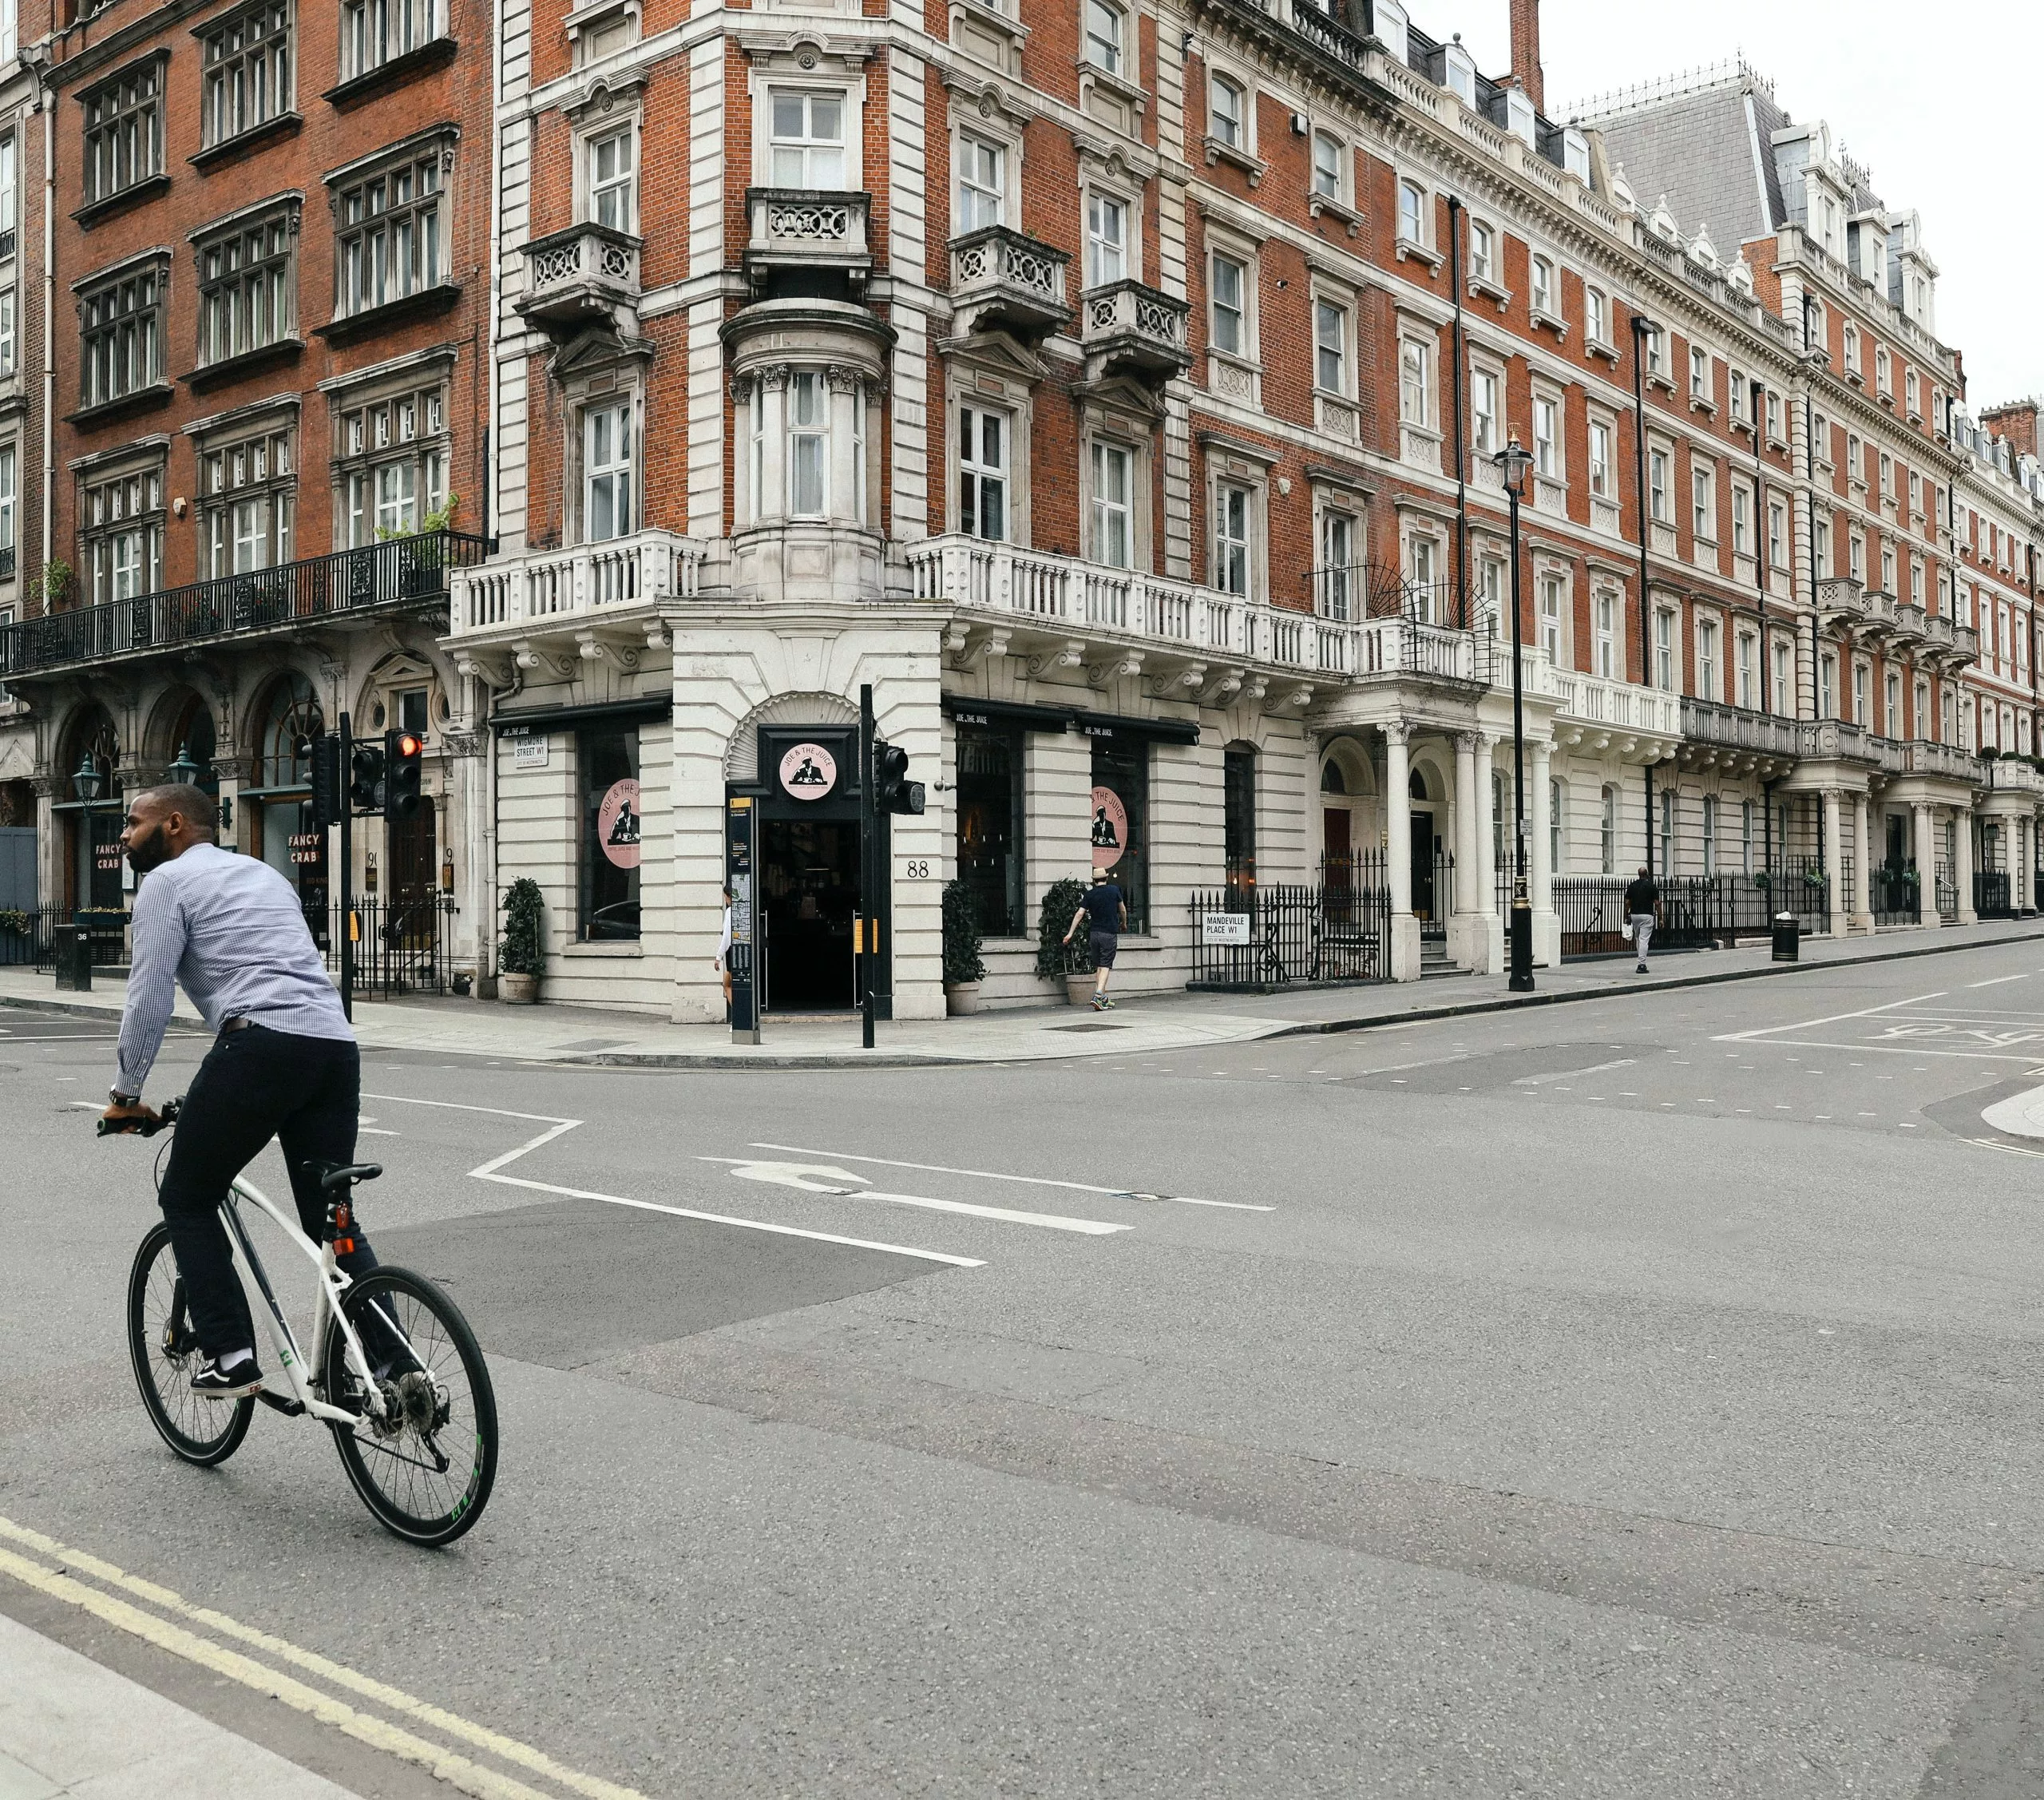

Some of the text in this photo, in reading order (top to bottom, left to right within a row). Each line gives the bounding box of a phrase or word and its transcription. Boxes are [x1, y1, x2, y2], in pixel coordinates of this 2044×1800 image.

[967, 714, 976, 724] THE
[517, 736, 543, 747] WIGMORE
[517, 747, 535, 757] STREET
[784, 753, 796, 767] JOE
[815, 751, 833, 767] JUICE
[602, 796, 614, 816] JOE
[612, 788, 620, 799] &
[620, 783, 635, 795] THE
[1095, 791, 1109, 803] THE
[1108, 798, 1125, 822] JUICE
[288, 835, 319, 846] FANCY
[96, 843, 121, 854] FANCY
[291, 851, 317, 863] CRAB
[97, 858, 119, 870] CRAB
[907, 860, 929, 878] 88
